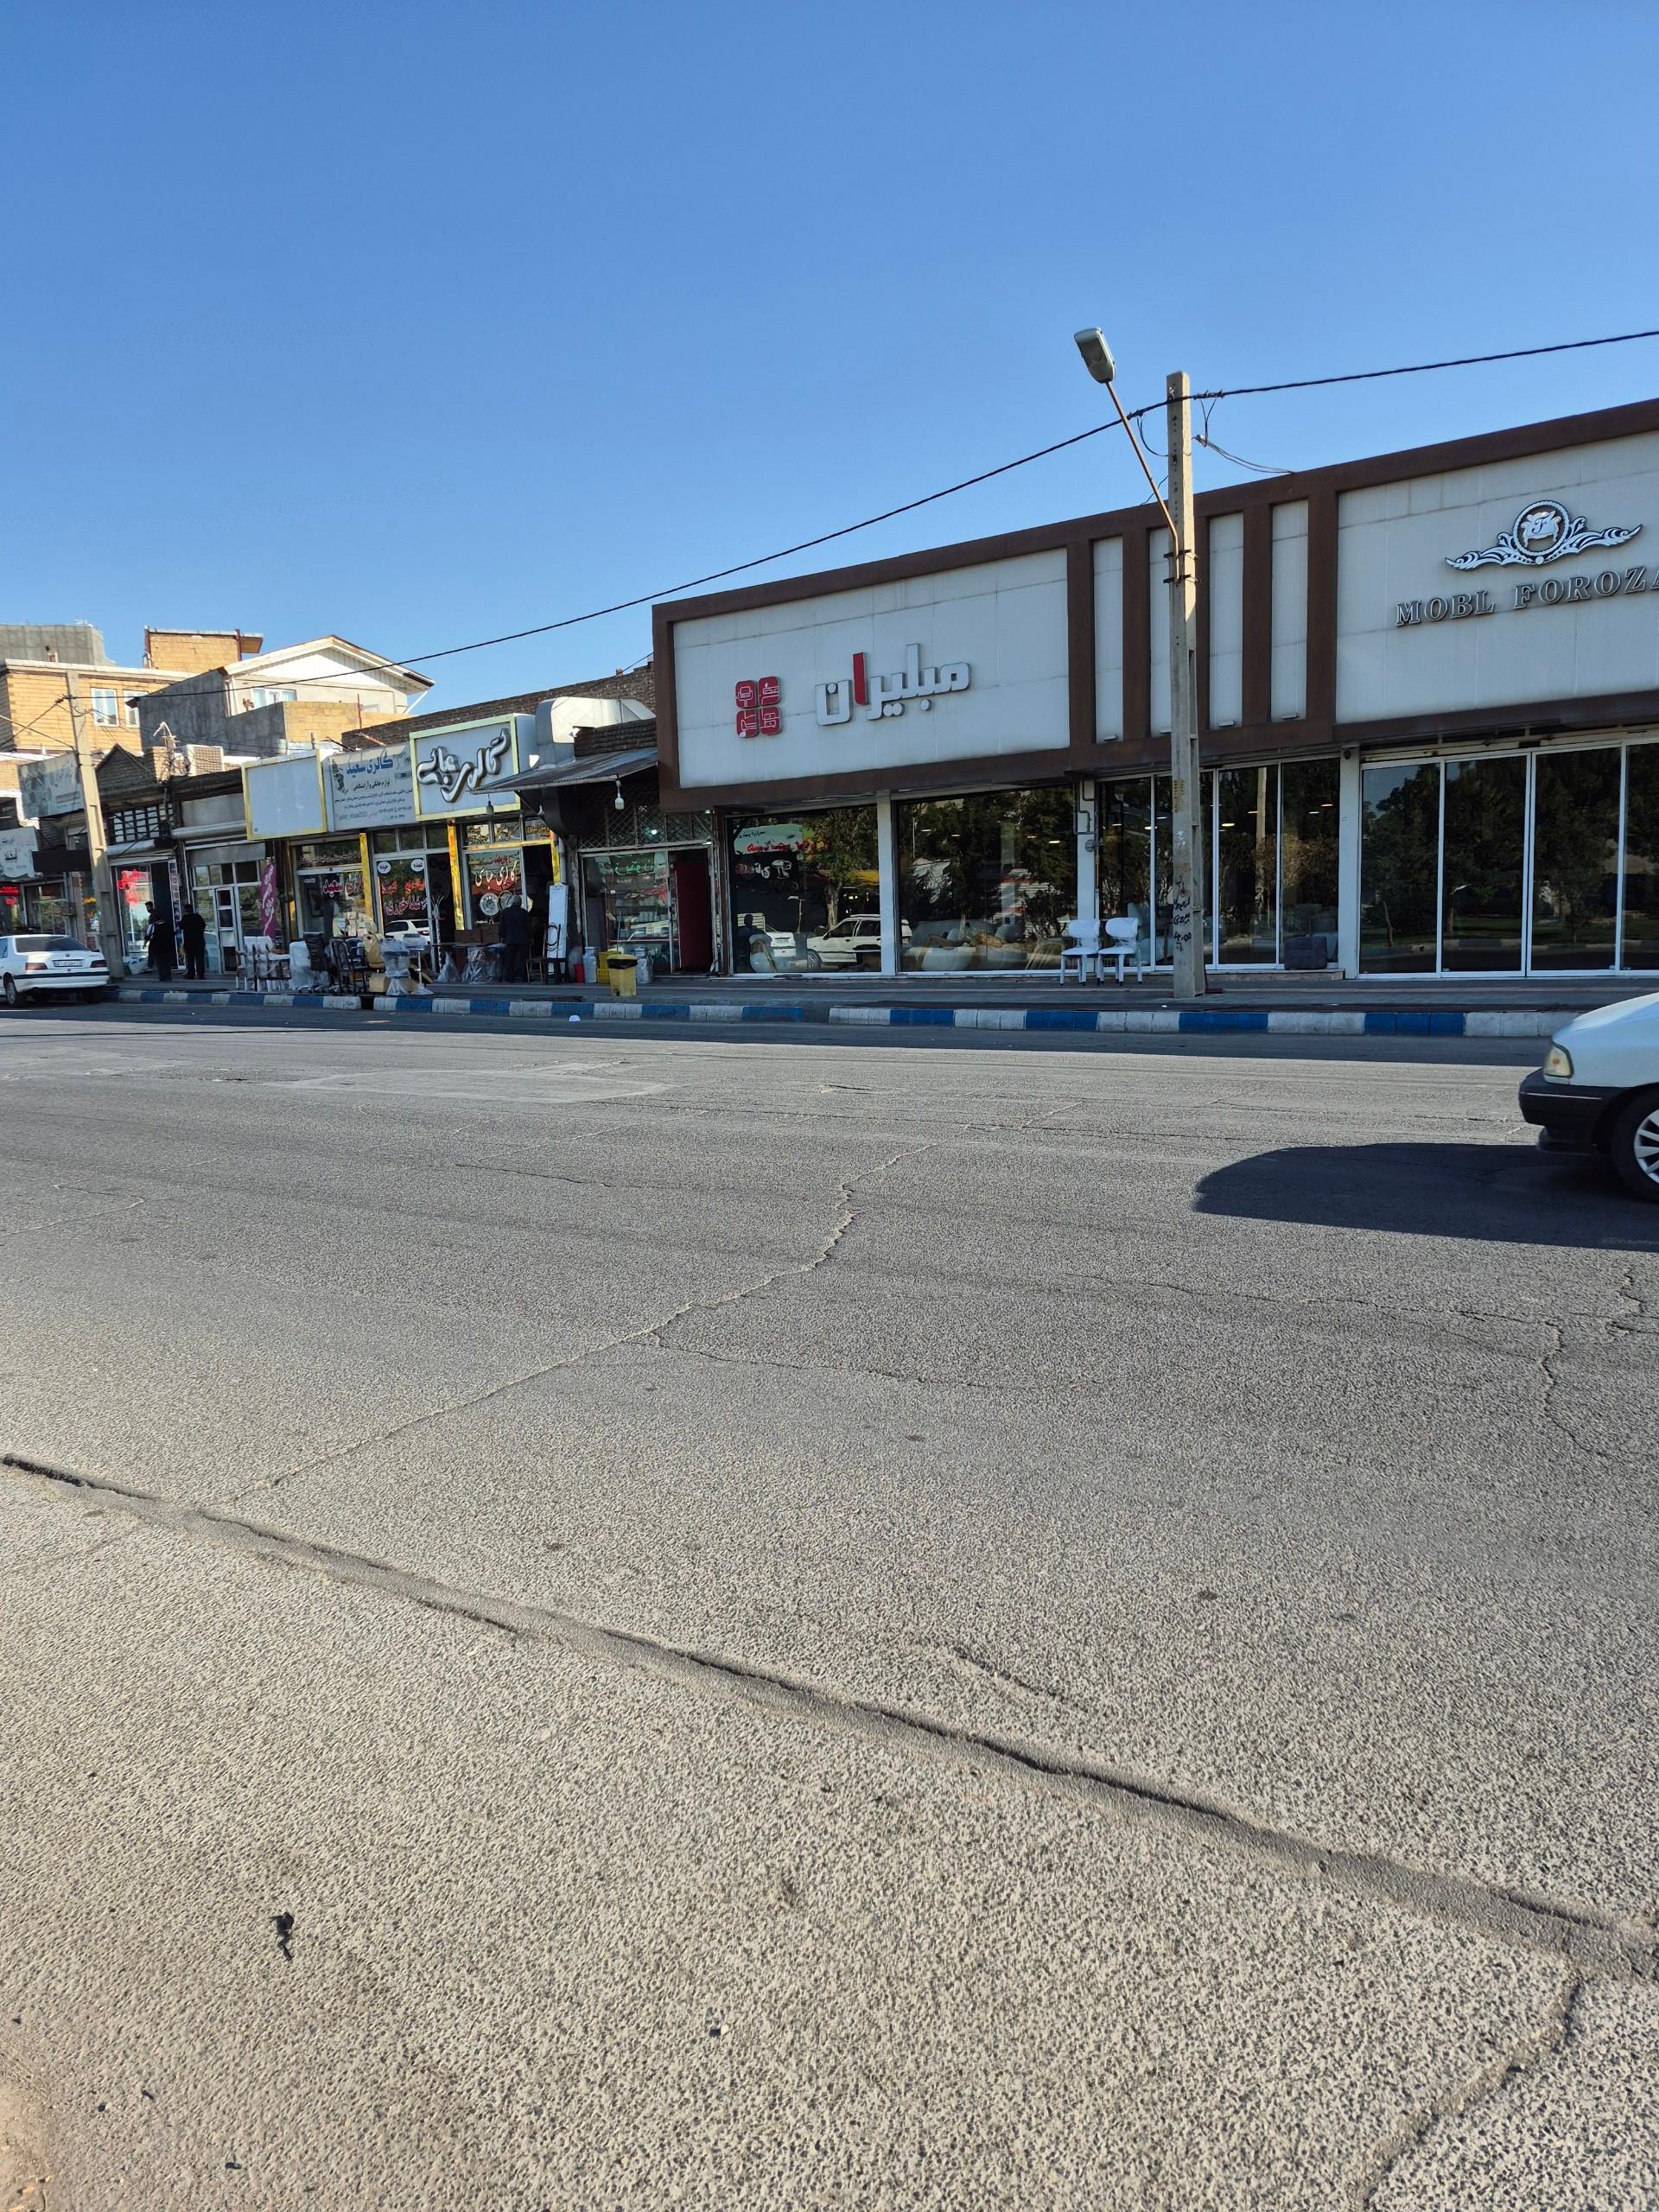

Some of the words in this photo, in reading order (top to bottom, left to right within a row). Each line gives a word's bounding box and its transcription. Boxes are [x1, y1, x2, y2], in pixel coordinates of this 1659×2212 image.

[1395, 589, 1495, 626] MOBL
[1514, 565, 1659, 610] FOROZ
[815, 643, 969, 726] مبلیران
[346, 763, 366, 778] سعید
[366, 750, 394, 775] گالری
[441, 728, 511, 803] گالری
[495, 860, 518, 887] گالری
[323, 880, 344, 898] سعید
